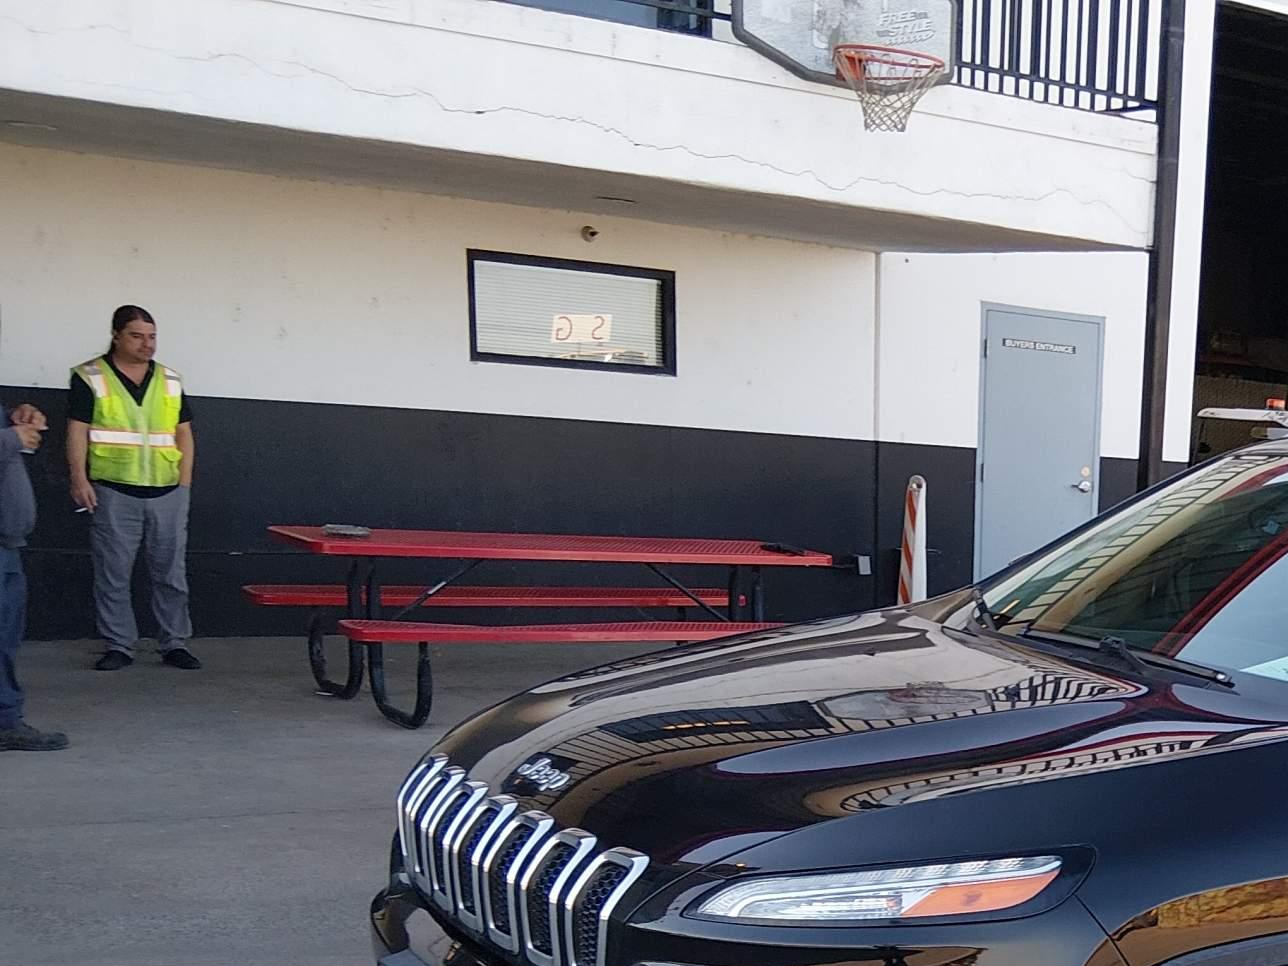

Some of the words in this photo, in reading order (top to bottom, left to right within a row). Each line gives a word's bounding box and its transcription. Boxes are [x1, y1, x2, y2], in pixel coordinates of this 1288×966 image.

[1005, 339, 1035, 349] BUYERS
[1035, 342, 1075, 353] ENTRANCE
[517, 757, 571, 791] Jeep
